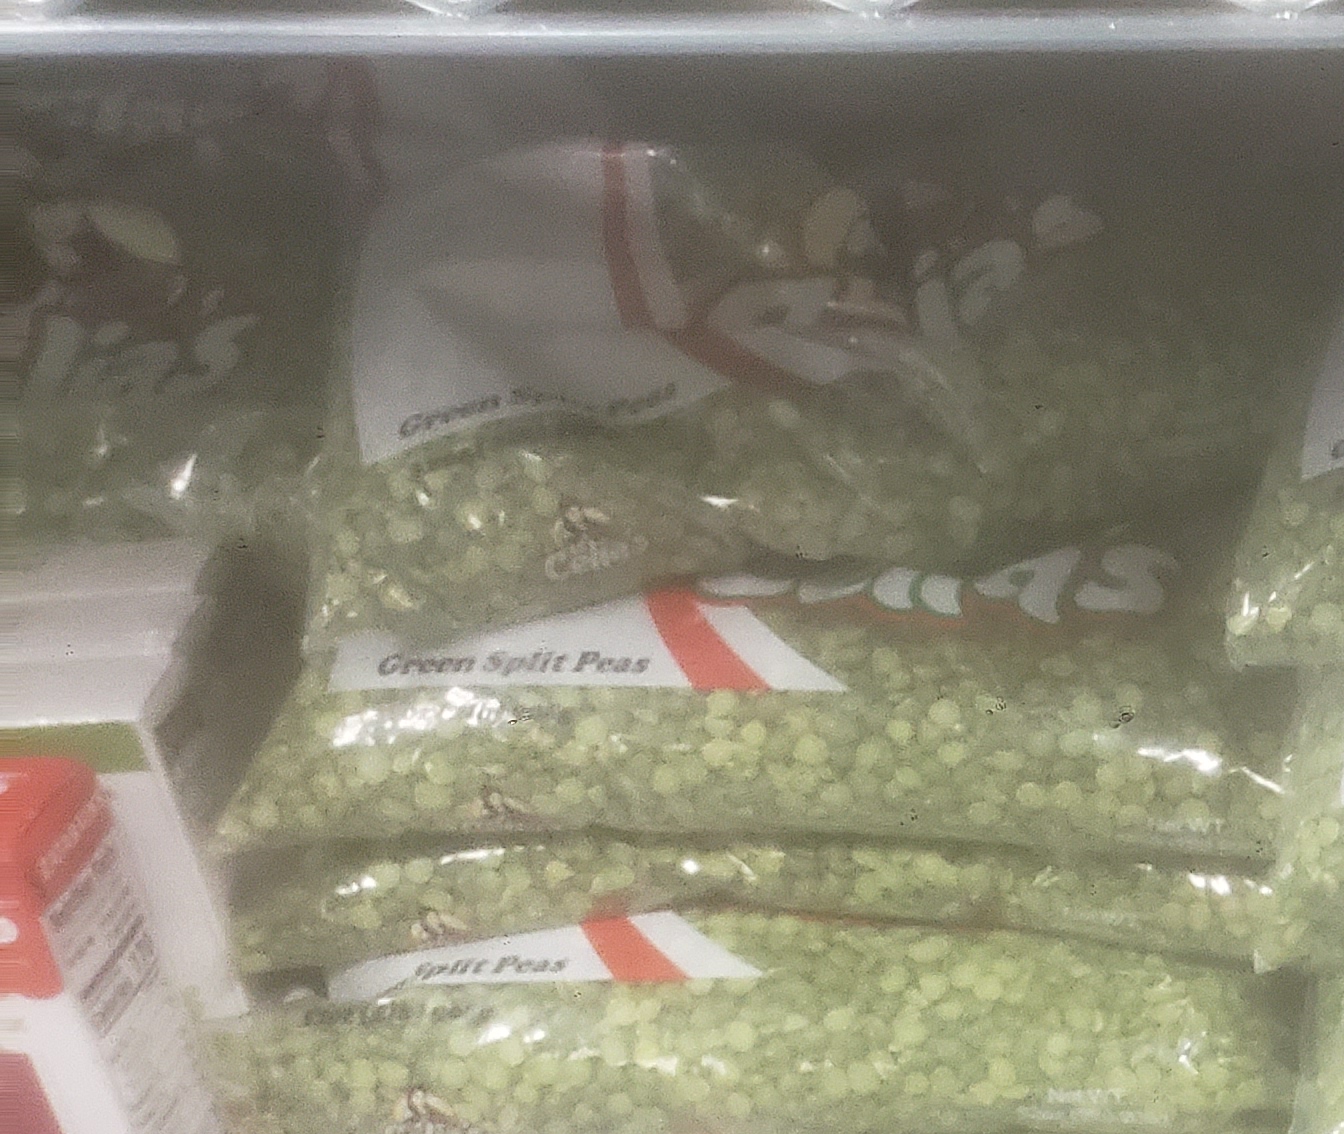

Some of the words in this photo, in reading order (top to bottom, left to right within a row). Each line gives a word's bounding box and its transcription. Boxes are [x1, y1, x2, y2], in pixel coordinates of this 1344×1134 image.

[399, 394, 499, 436] Green
[377, 652, 477, 677] Green
[482, 650, 569, 677] Split
[572, 650, 651, 674] Peas
[491, 955, 569, 974] Peas
